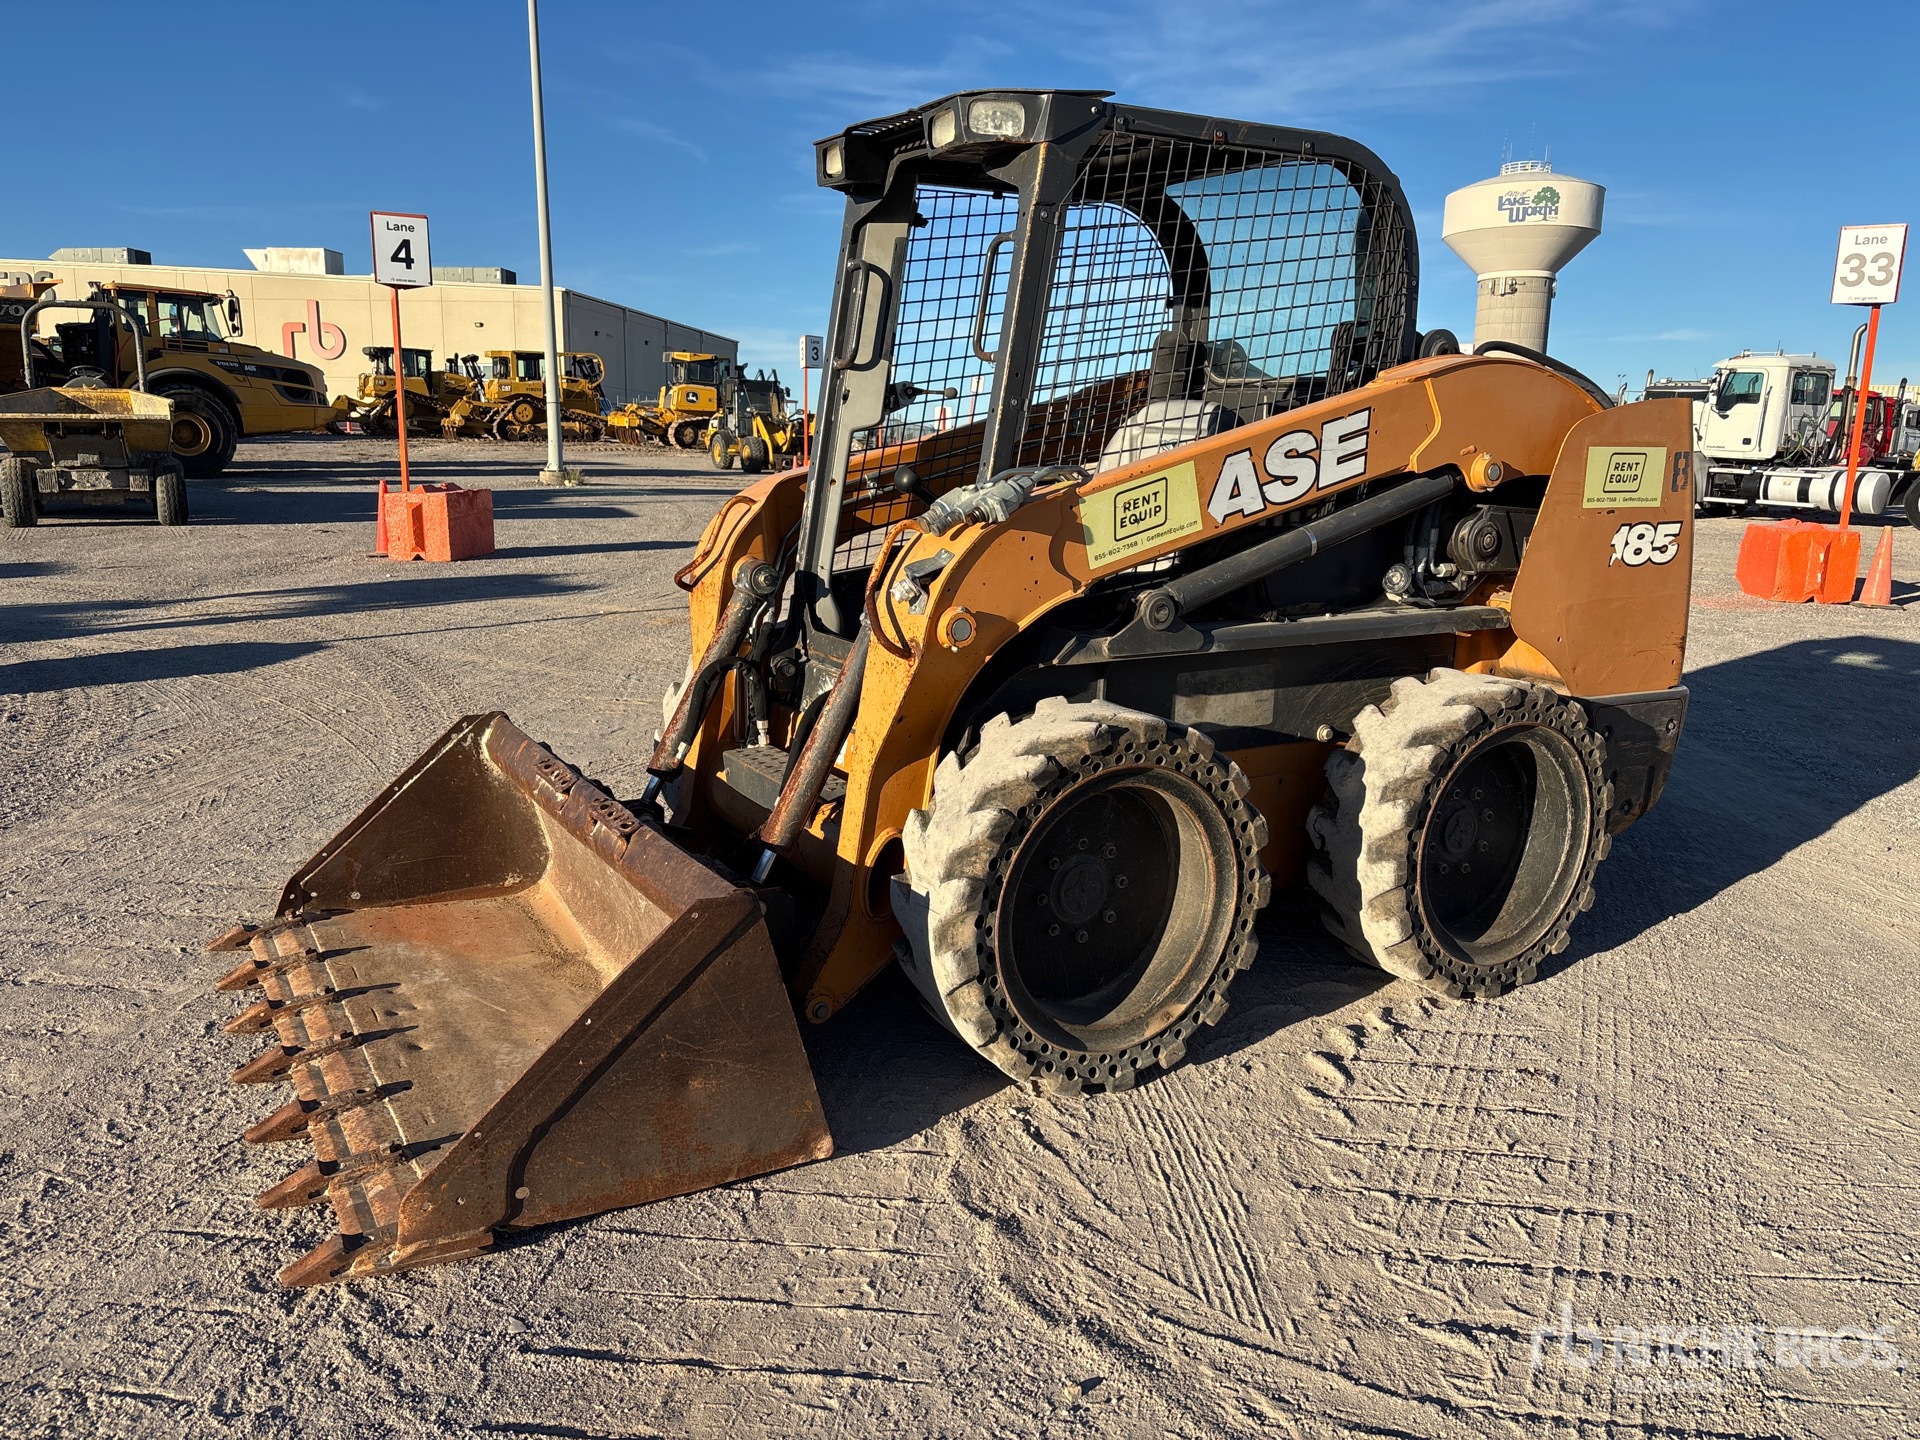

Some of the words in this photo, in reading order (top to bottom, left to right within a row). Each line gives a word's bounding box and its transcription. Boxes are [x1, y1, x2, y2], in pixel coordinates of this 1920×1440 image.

[1497, 196, 1531, 211] LAKE
[1508, 206, 1559, 223] WORTH
[386, 221, 415, 232] Lane
[1854, 234, 1888, 245] Lane
[390, 238, 415, 270] 4
[1839, 252, 1896, 287] 33
[811, 346, 819, 361] 3
[1207, 406, 1371, 524] ASE
[1614, 462, 1640, 471] RENT
[1609, 474, 1639, 483] EQUIP
[1123, 491, 1160, 513] RENT
[1120, 505, 1162, 529] EQUIP
[1094, 541, 1138, 561] 855-802-7368
[1146, 520, 1198, 542] GetRentEquip.com
[1608, 521, 1684, 567] 185
